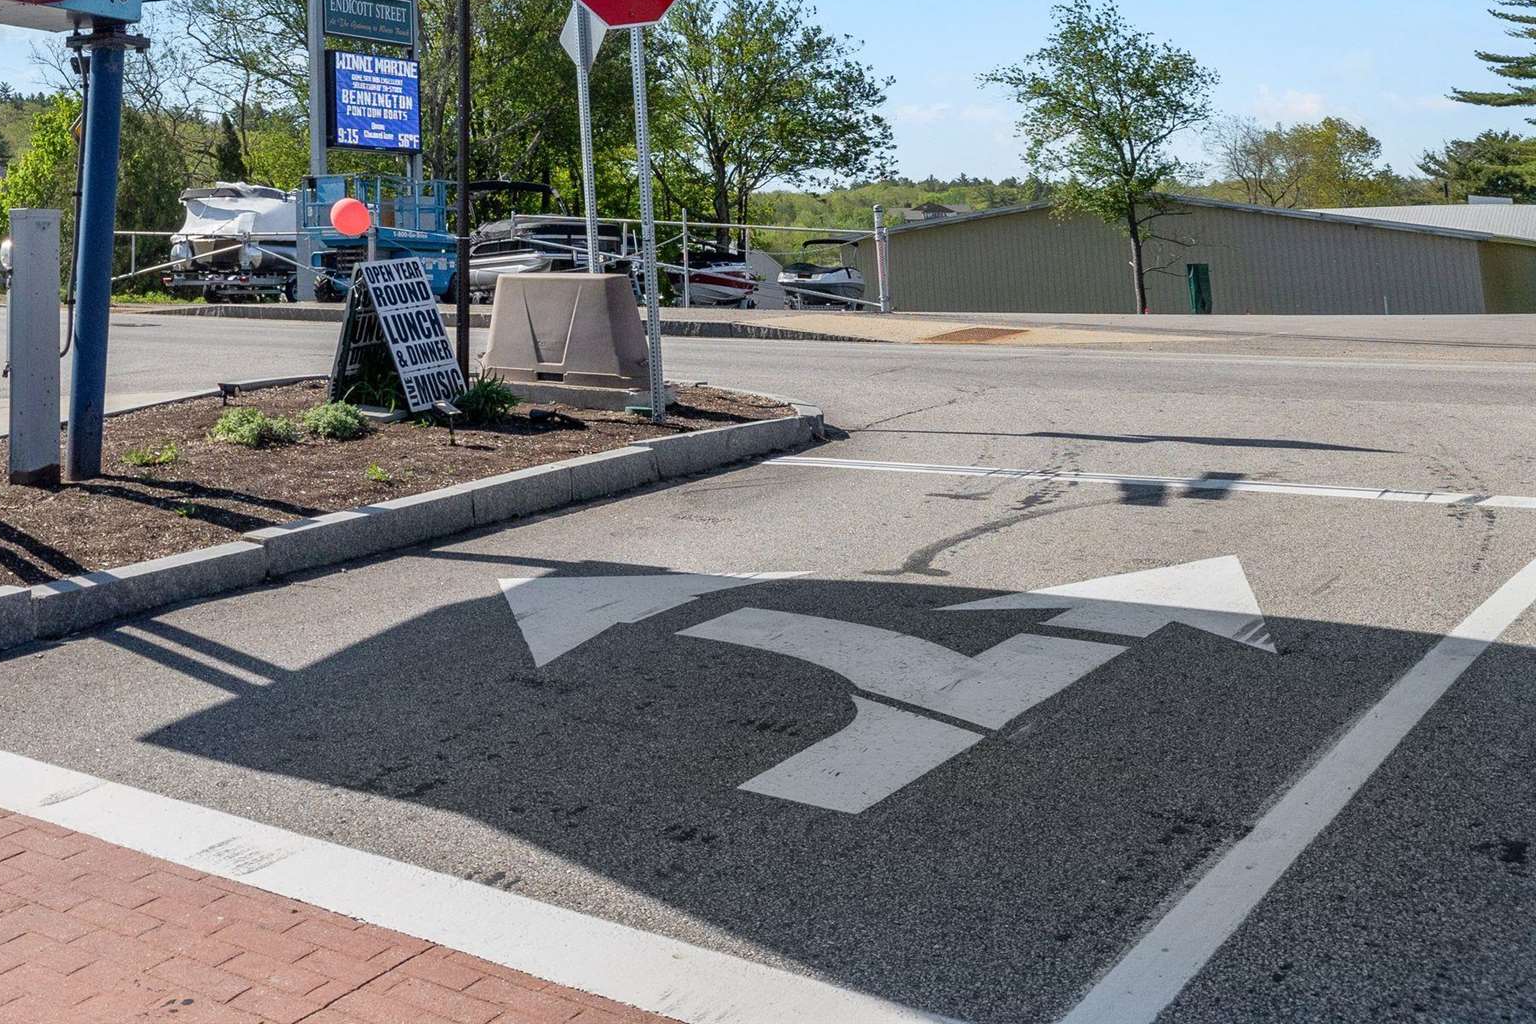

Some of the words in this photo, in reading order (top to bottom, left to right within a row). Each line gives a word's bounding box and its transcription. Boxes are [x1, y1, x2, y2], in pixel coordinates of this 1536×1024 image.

[375, 4, 407, 23] STREET
[335, 52, 373, 73] WINNI
[374, 57, 418, 79] MARINE
[341, 89, 413, 110] BENNINGTON
[347, 105, 382, 118] PONTOON
[383, 108, 408, 121] BOATS
[337, 127, 359, 144] 9:15
[365, 264, 395, 284] OPEN
[394, 261, 423, 281] YEAR
[372, 281, 431, 307] ROUND
[383, 308, 444, 345] LUNCH
[397, 350, 408, 368] &
[408, 339, 453, 366] DINNER
[404, 376, 420, 407] LIVE
[414, 368, 465, 405] MUSIC
